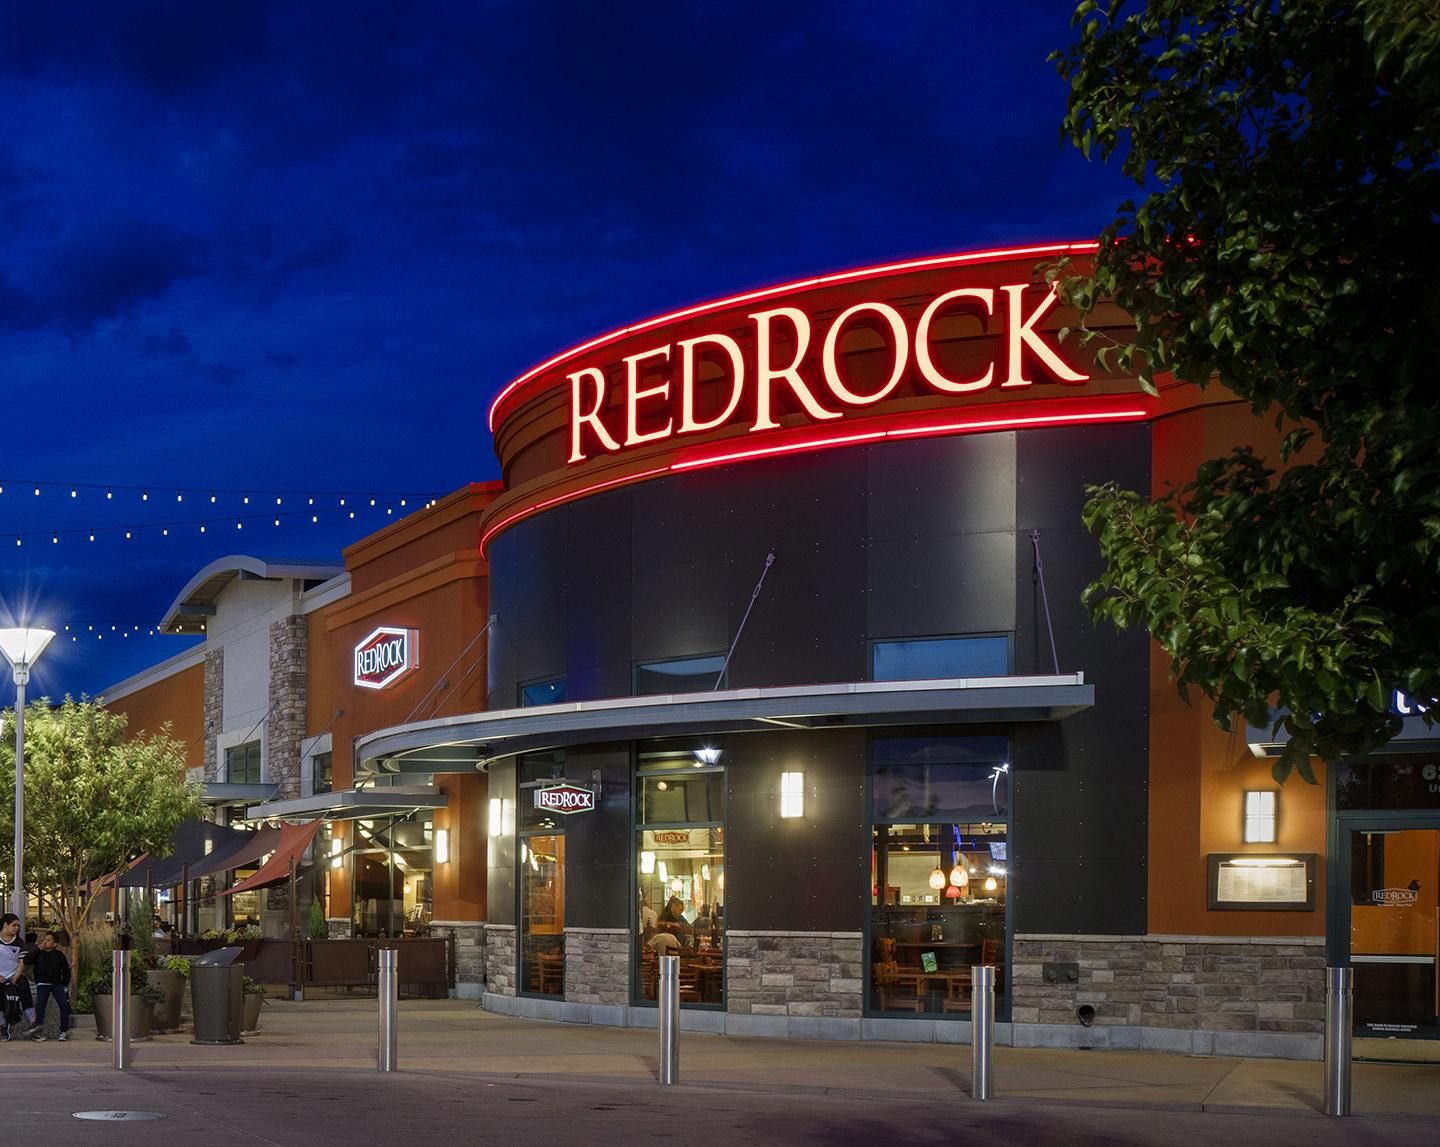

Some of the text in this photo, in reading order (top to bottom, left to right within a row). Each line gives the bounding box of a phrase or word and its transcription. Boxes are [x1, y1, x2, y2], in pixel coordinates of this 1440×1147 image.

[566, 280, 1090, 464] REDROCK
[358, 638, 404, 676] REDROCK
[542, 791, 592, 807] REDROCK
